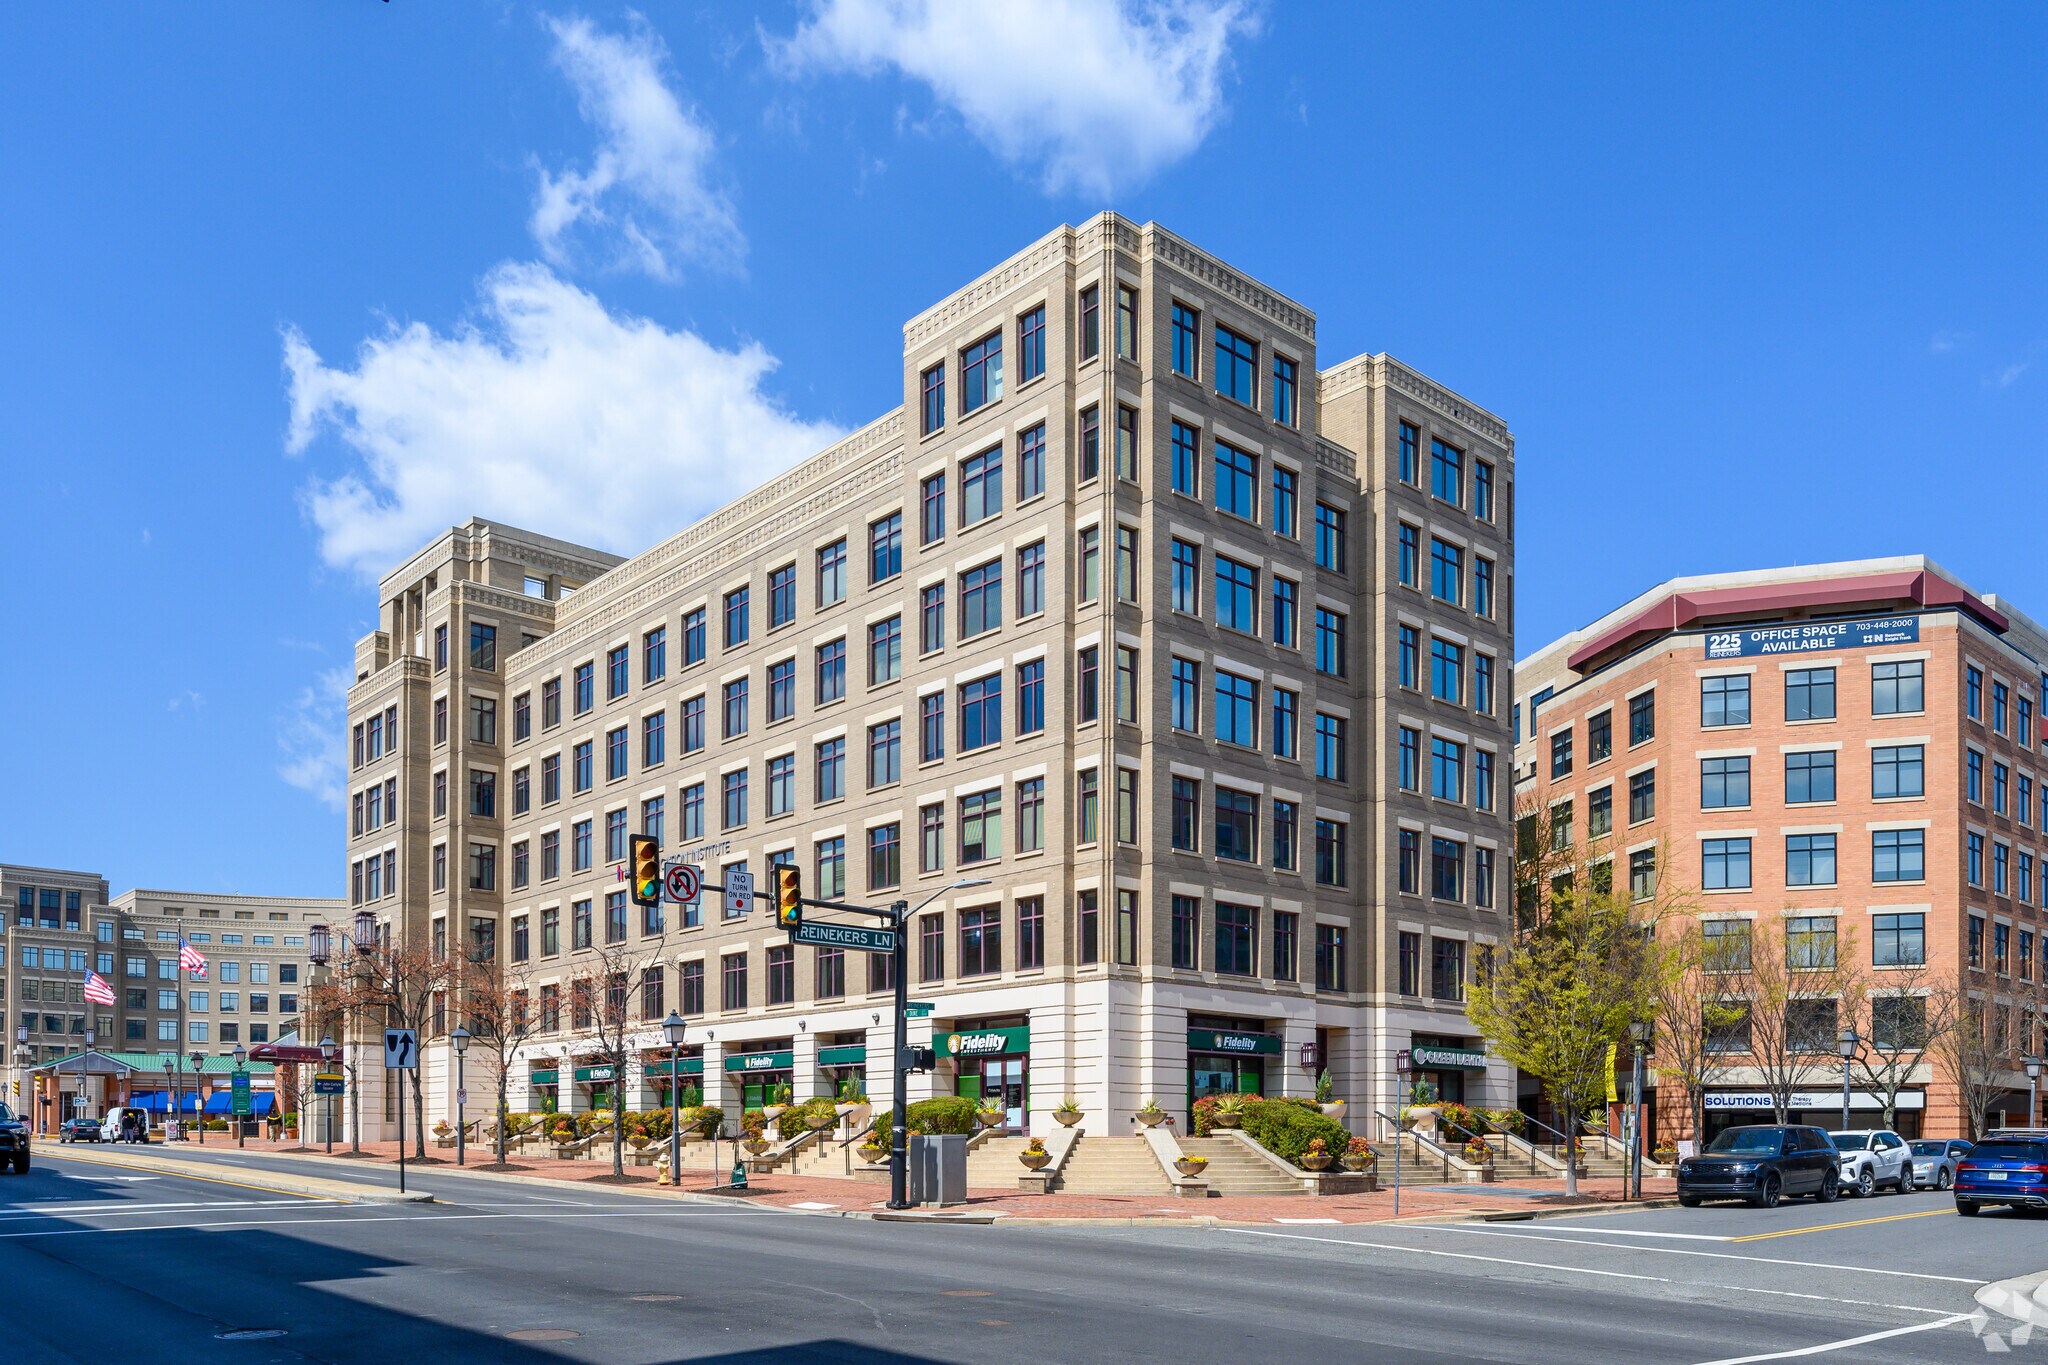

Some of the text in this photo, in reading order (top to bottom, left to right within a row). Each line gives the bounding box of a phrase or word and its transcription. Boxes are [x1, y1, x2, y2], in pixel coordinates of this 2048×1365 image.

[1855, 619, 1913, 631] 703-448-2000
[1751, 624, 1847, 642] OFFICE SPACE
[1710, 633, 1741, 649] 225
[1761, 637, 1836, 653] AVAILABLE
[733, 874, 746, 883] NO
[732, 884, 748, 892] TURN
[728, 891, 751, 900] ON RED
[800, 925, 890, 946] REINEKERS LN
[960, 1034, 1006, 1051] Fidelity
[1223, 1036, 1256, 1050] Fidelity
[750, 1056, 773, 1067] Fidelity
[1427, 1051, 1456, 1065] GREEN
[1705, 1097, 1771, 1106] SOLUTIONS
